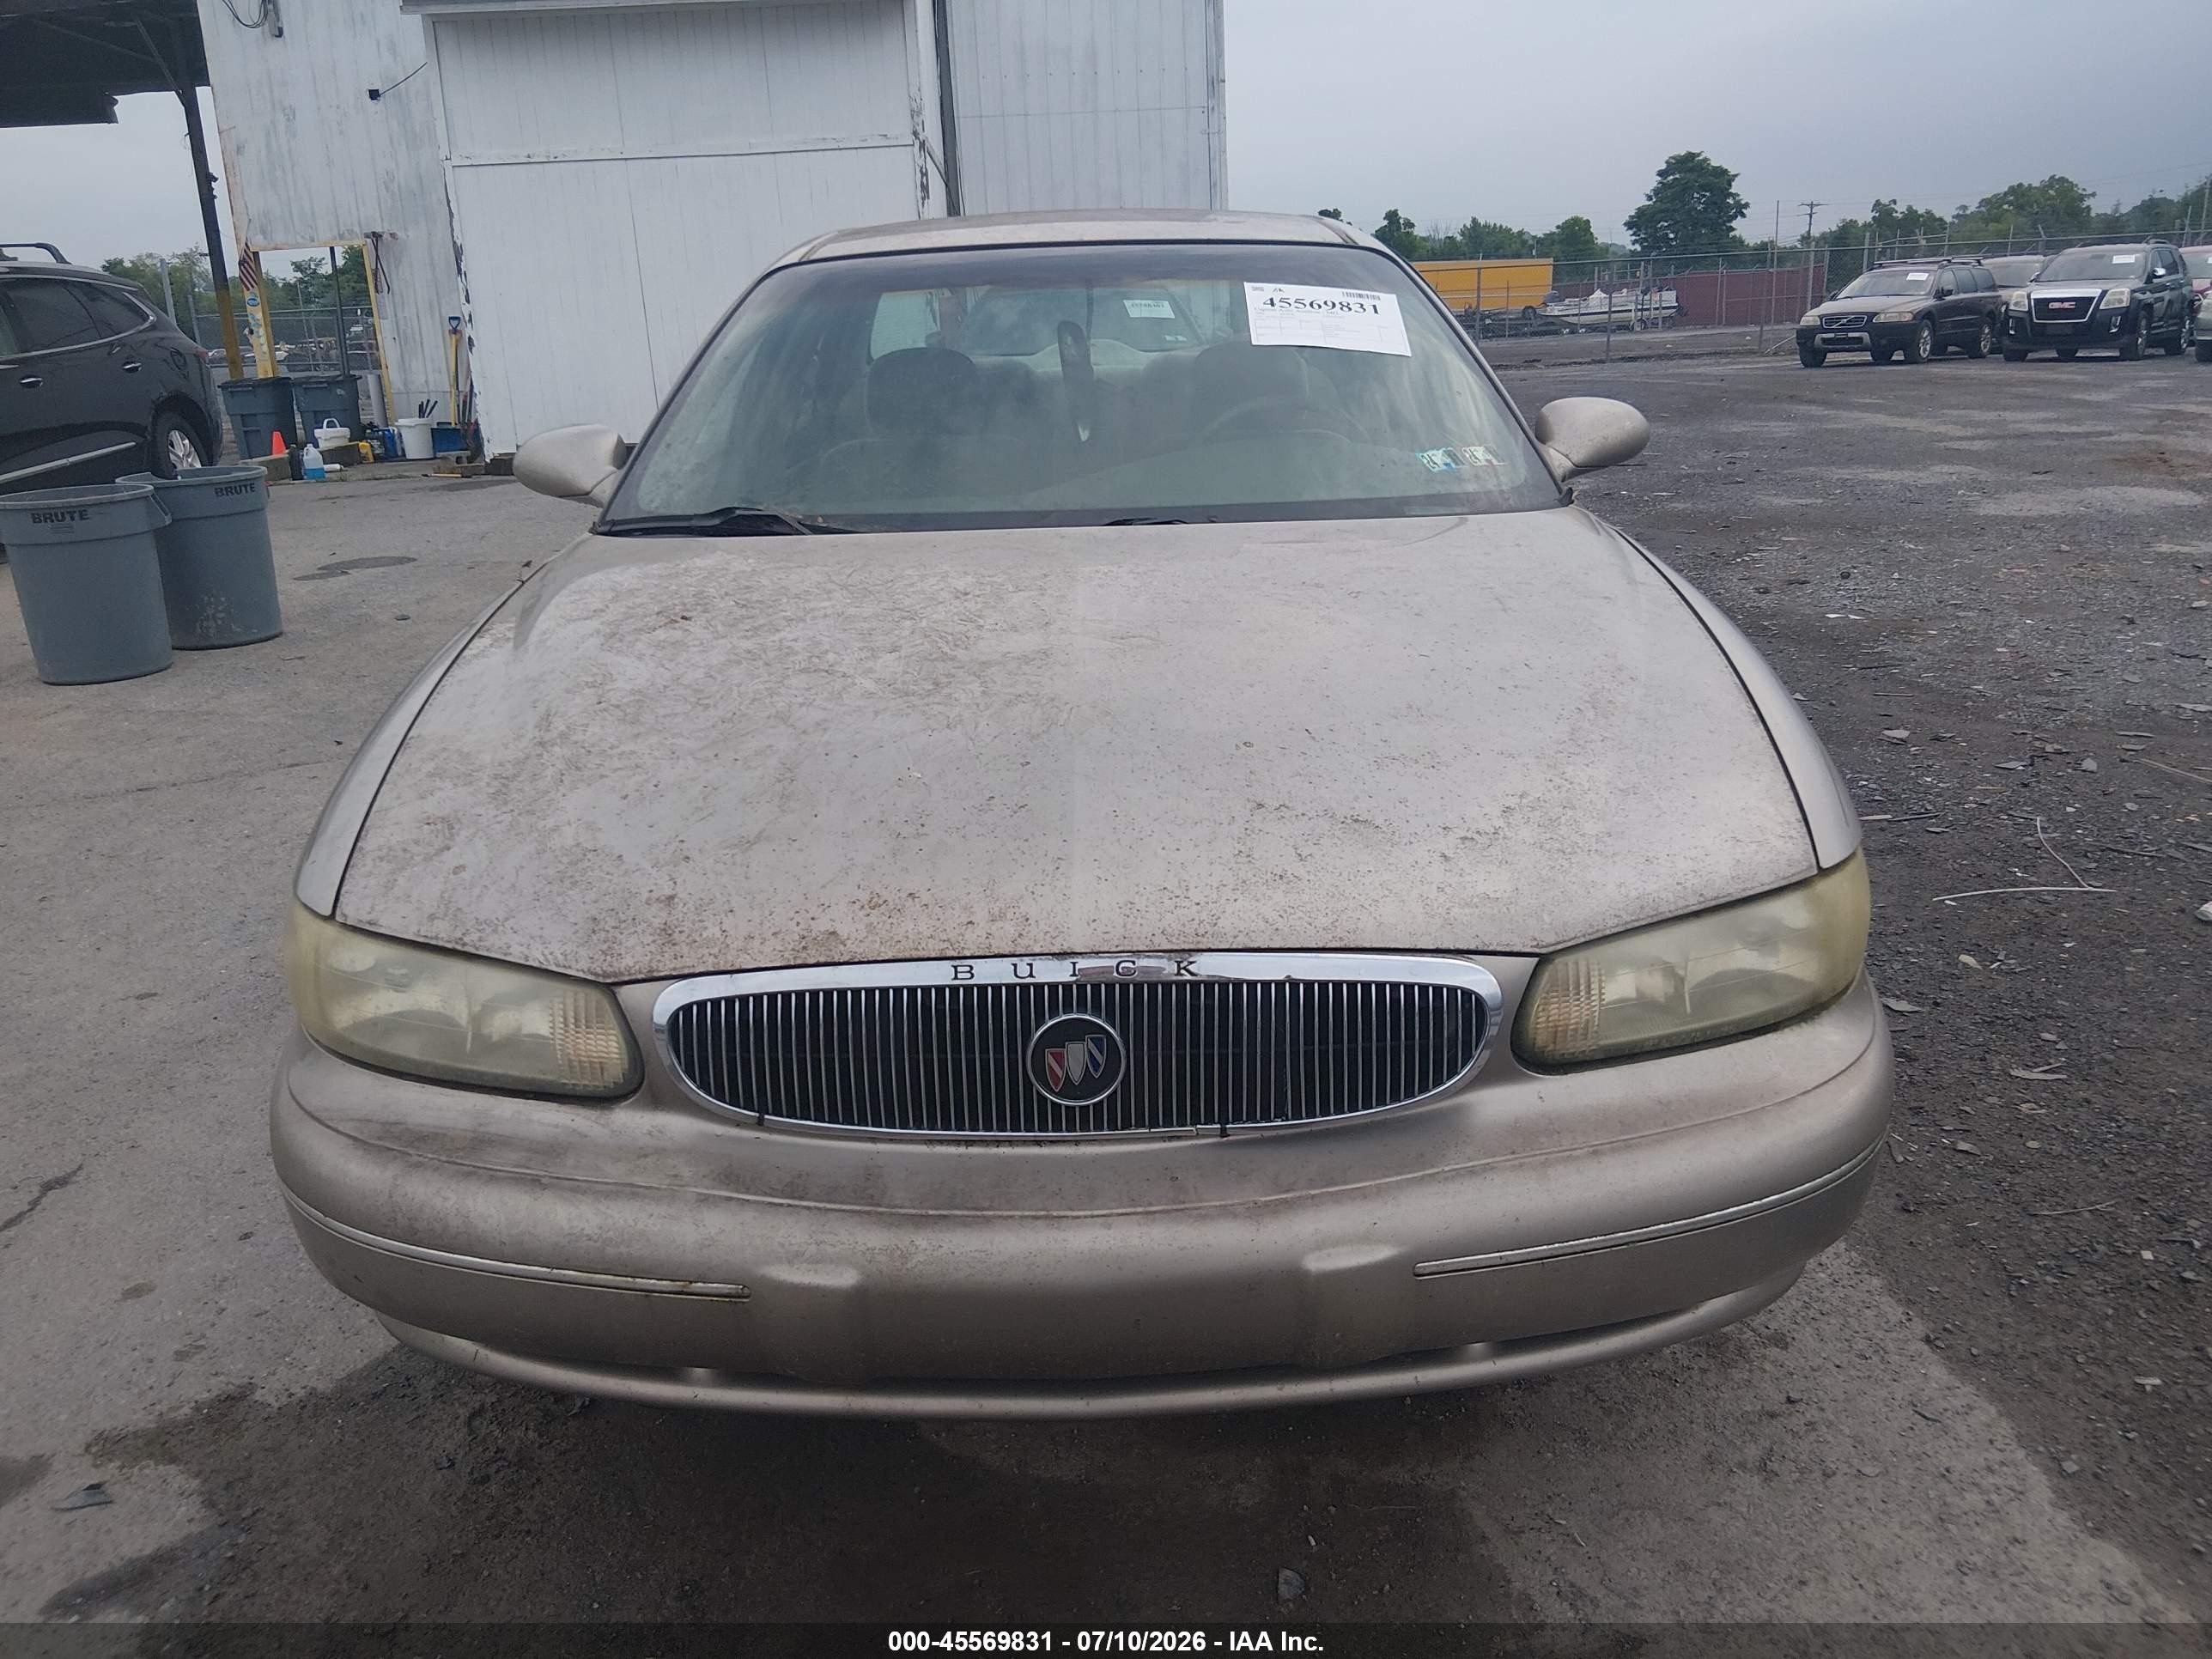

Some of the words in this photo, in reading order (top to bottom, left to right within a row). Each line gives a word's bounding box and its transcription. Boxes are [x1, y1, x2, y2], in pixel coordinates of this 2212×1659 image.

[1262, 297, 1381, 315] 45569831
[214, 483, 255, 496] BRUTE
[31, 509, 89, 524] BRUTE
[951, 959, 1199, 981] BUICK
